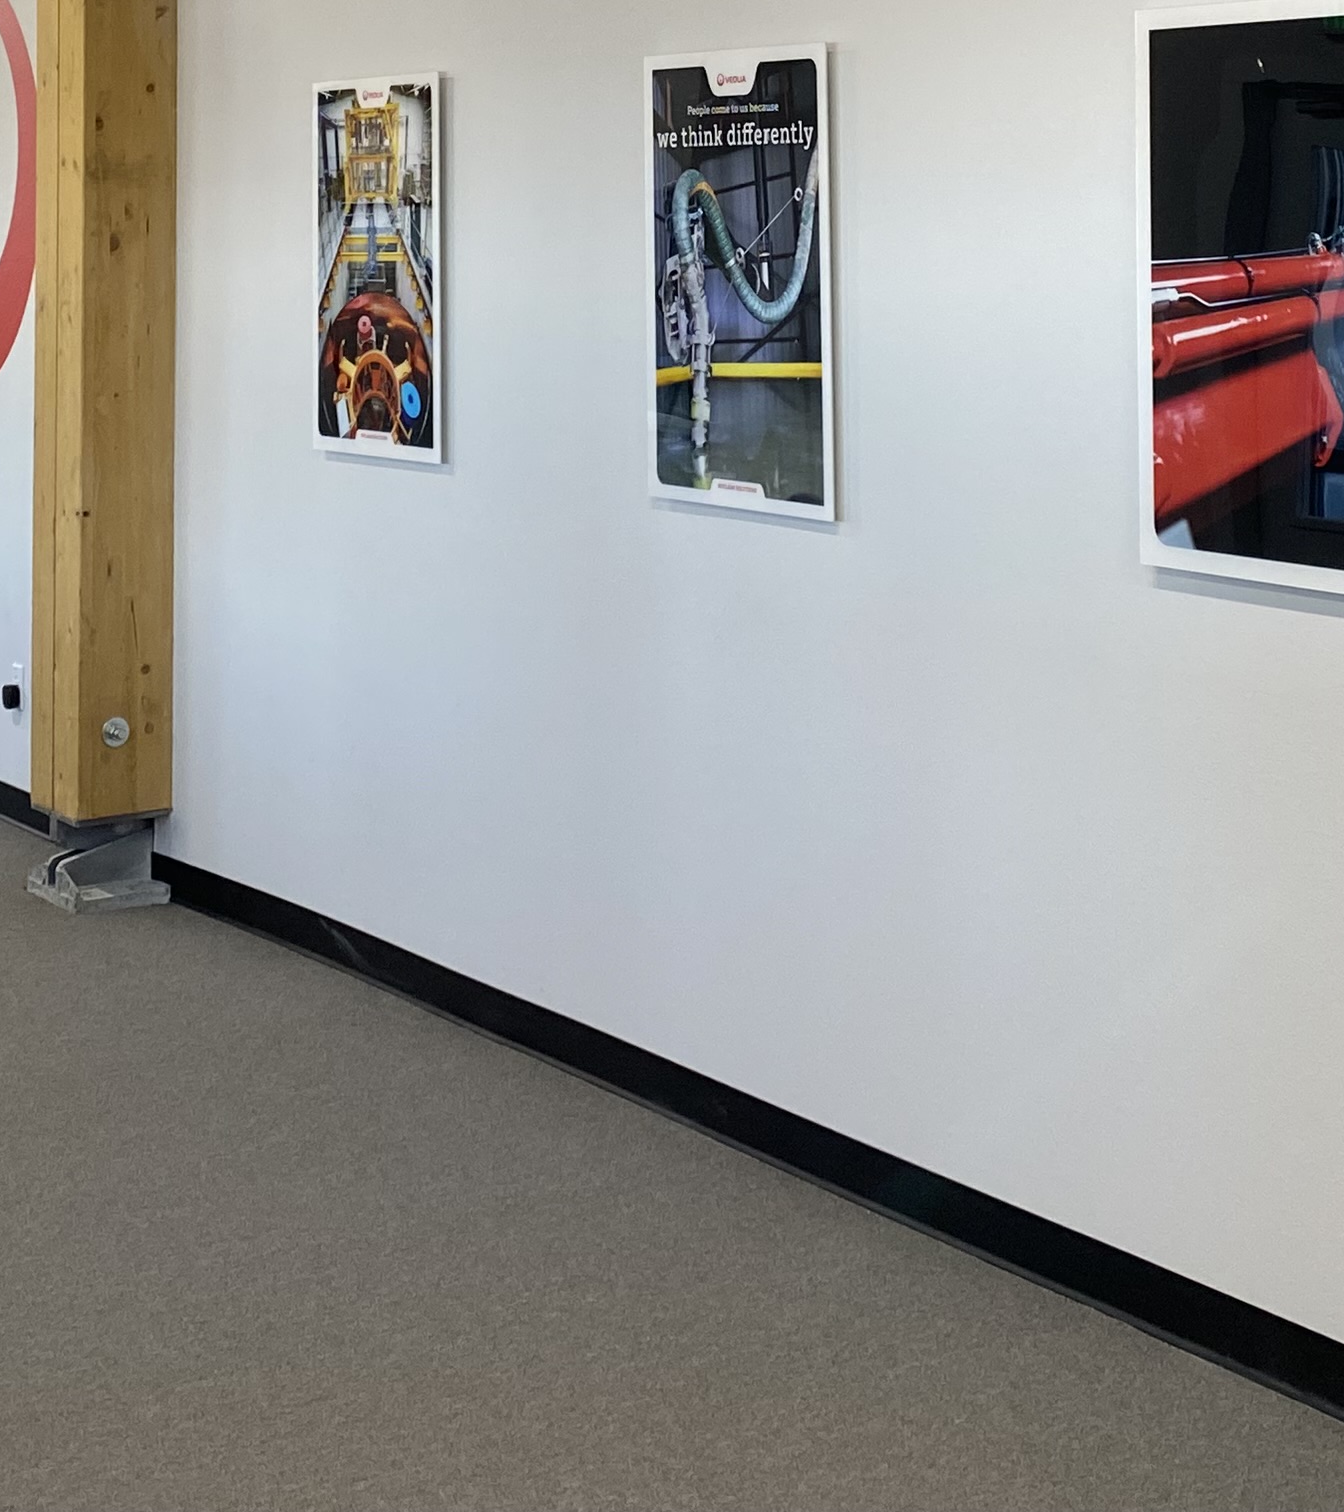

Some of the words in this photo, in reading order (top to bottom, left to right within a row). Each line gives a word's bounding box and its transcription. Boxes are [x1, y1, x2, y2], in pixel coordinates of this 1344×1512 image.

[687, 105, 710, 117] People
[711, 106, 730, 114] come
[731, 104, 738, 114] to
[739, 105, 748, 113] us
[749, 103, 779, 113] because
[657, 130, 678, 148] we
[681, 124, 723, 148] think
[727, 120, 814, 150] differently
